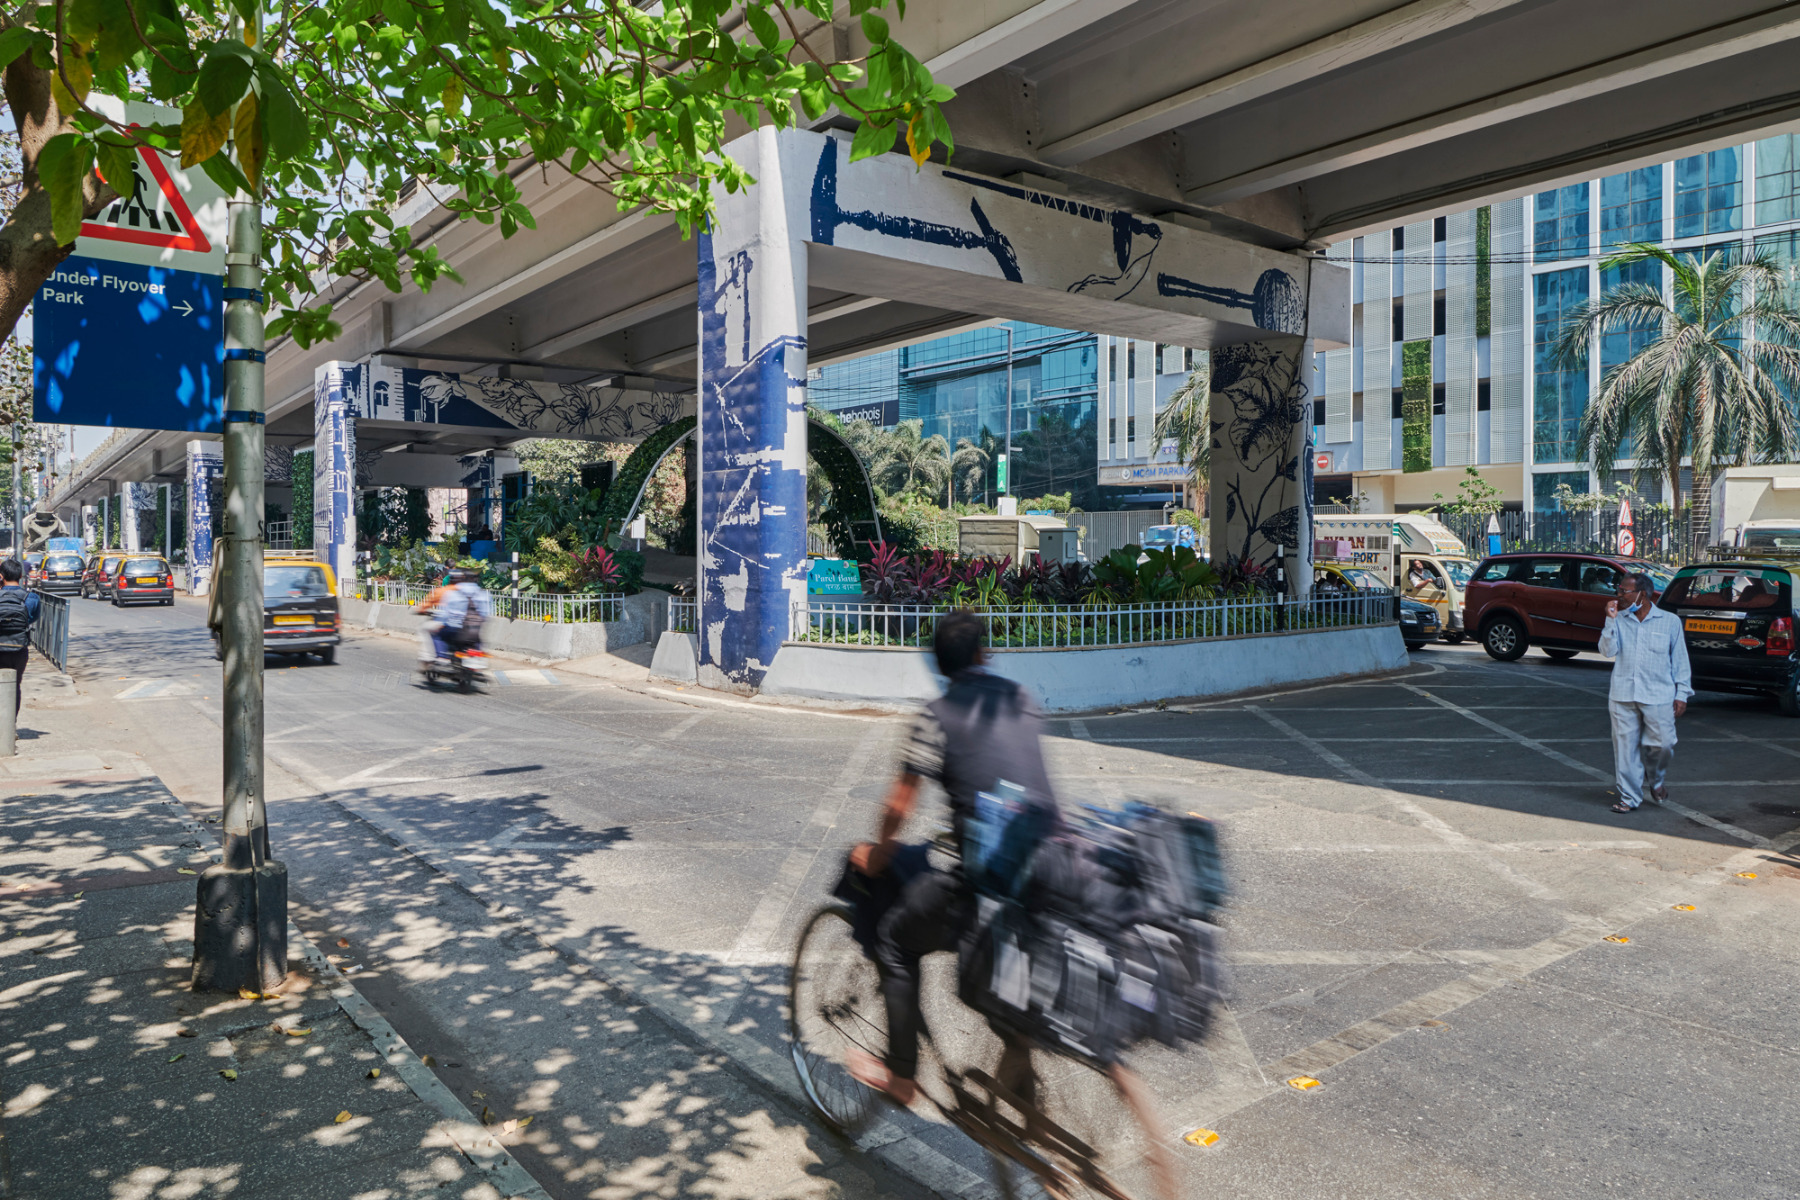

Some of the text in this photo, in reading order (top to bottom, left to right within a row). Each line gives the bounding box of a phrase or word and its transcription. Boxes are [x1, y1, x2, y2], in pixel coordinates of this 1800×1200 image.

[102, 275, 166, 295] Flyover
[43, 287, 84, 305] Park
[1350, 552, 1380, 564] PORT
